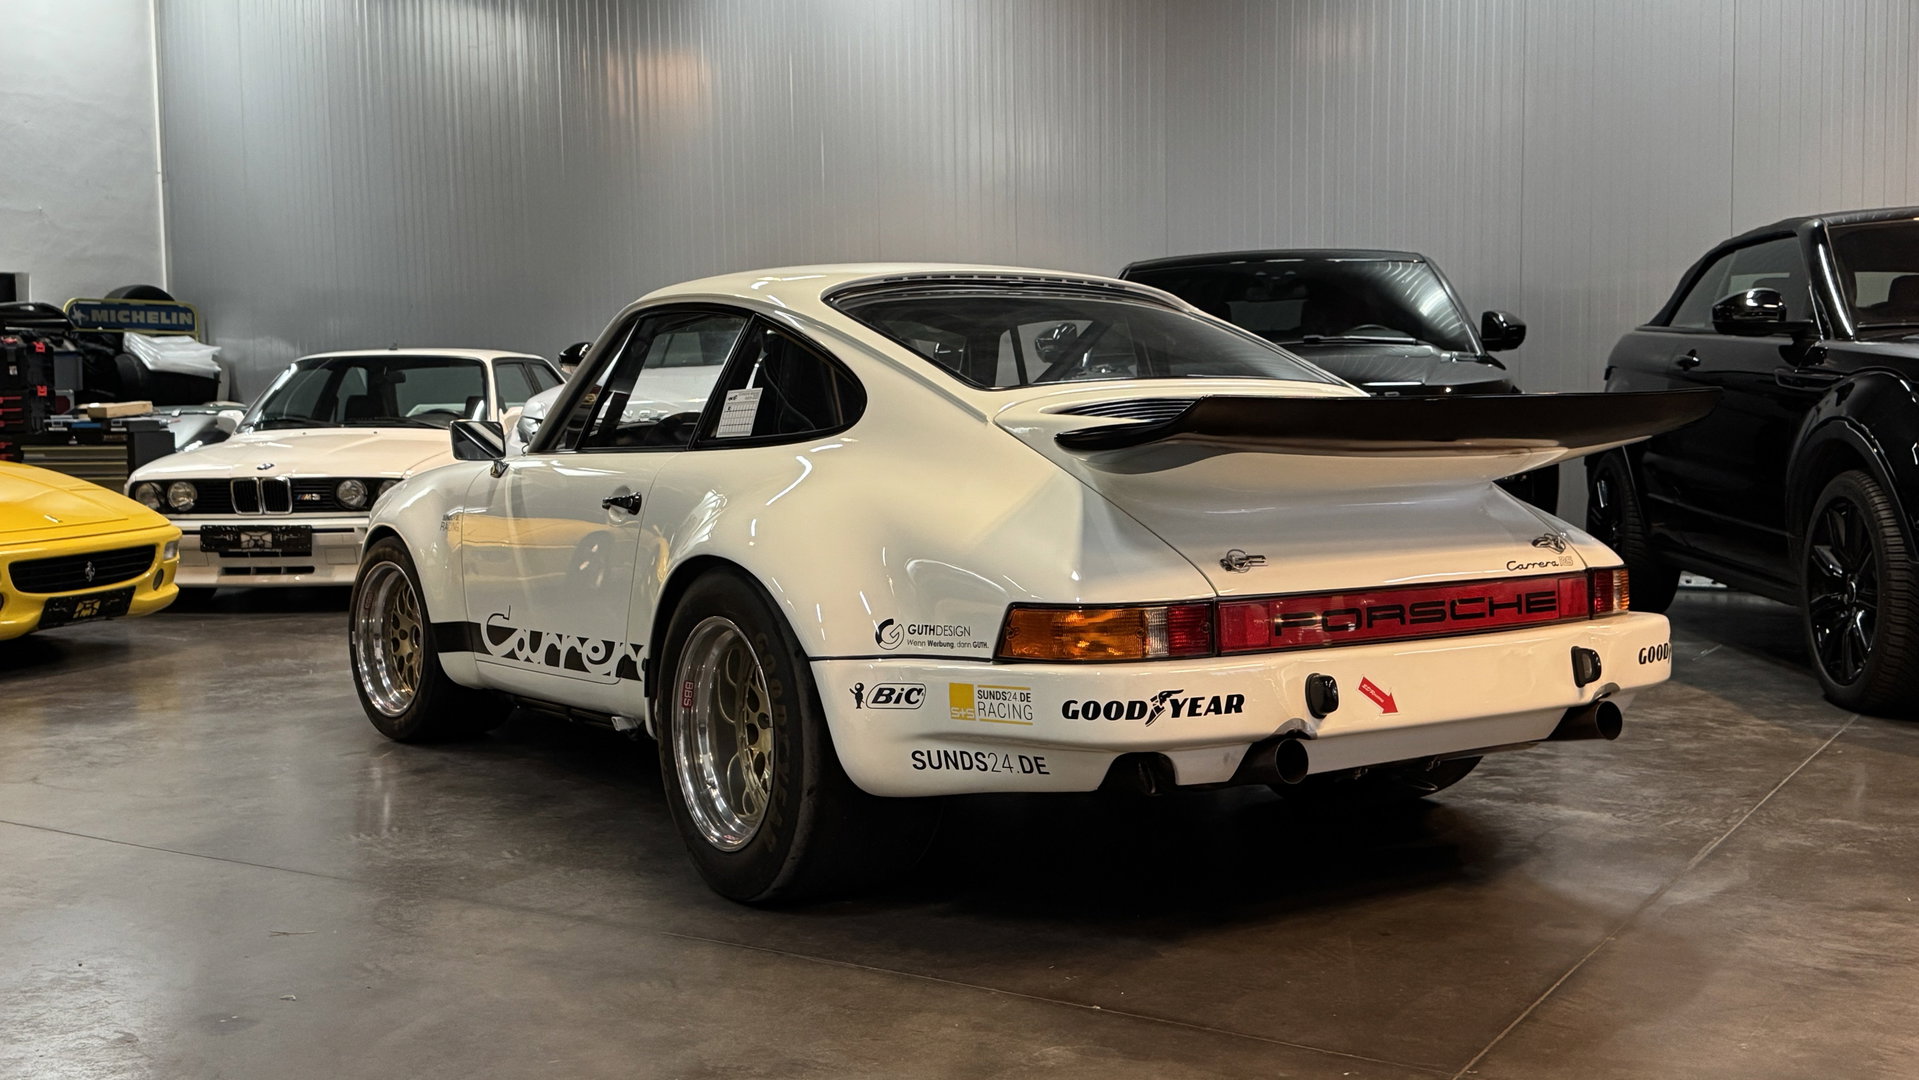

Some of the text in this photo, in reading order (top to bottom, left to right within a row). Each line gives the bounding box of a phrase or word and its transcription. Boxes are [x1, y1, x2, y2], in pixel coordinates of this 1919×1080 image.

[90, 309, 193, 325] MICHELIN
[1506, 560, 1559, 571] Carrera
[1274, 591, 1556, 636] PORSCHE
[907, 624, 971, 637] GUTHDESIGN
[907, 639, 926, 647] Wenn
[683, 681, 694, 707] BBS
[977, 689, 1032, 702] SUNDS24.DE
[978, 702, 1033, 721] RACING
[911, 750, 1051, 775] SUNDS24.DE
